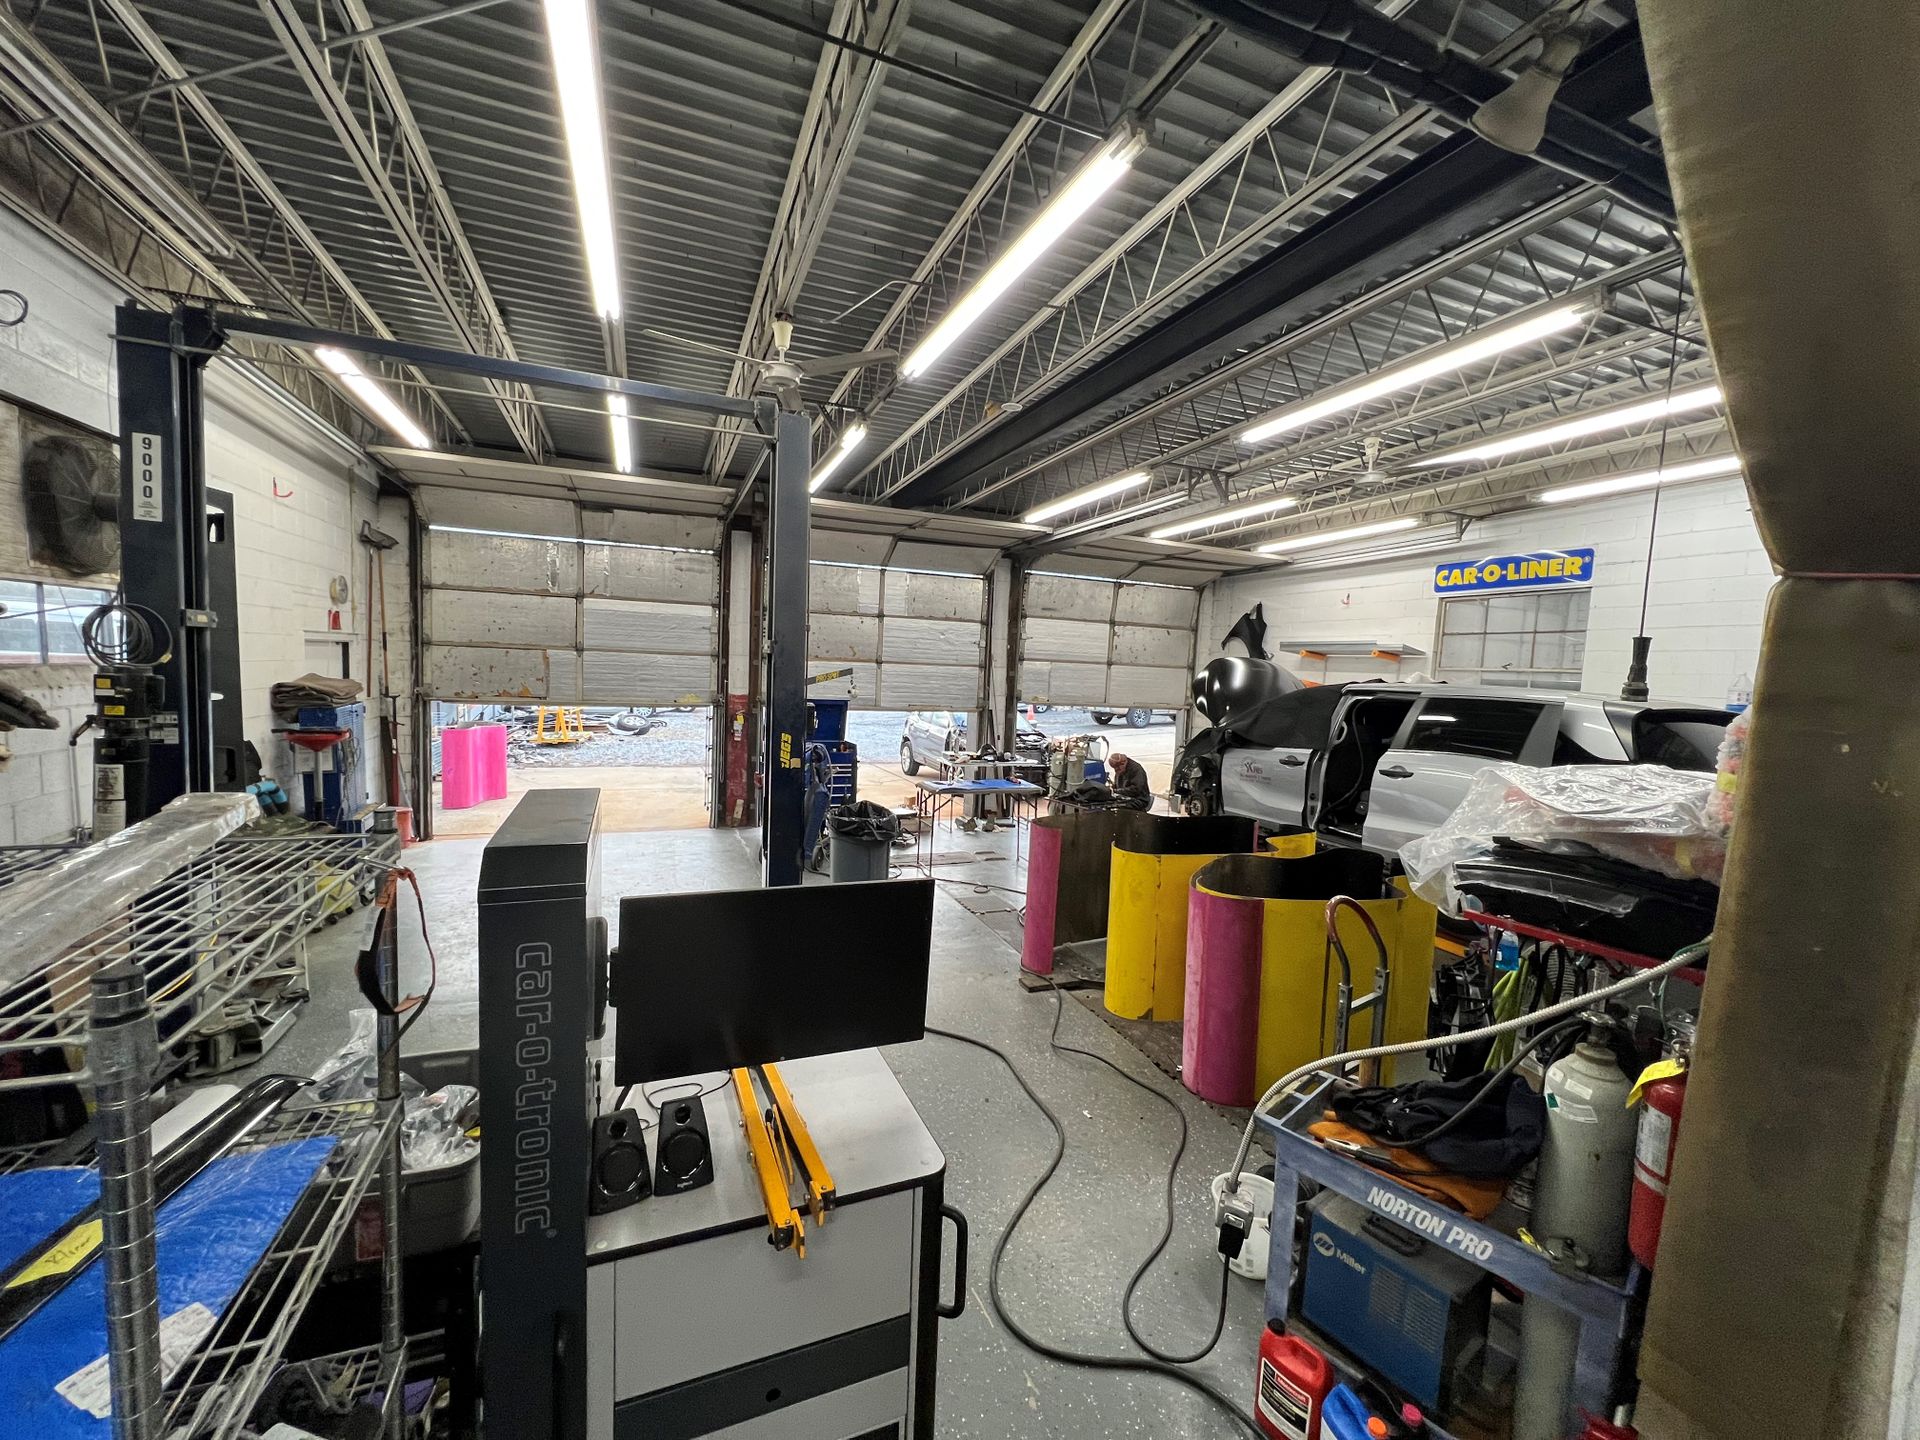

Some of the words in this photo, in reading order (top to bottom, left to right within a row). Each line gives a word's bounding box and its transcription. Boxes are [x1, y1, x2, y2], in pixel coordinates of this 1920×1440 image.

[142, 437, 153, 498] 9000
[1436, 556, 1584, 587] CAR-O-LINER
[780, 732, 792, 769] JEGS
[1367, 1186, 1448, 1238] NORTON
[1445, 1225, 1494, 1261] PRO
[1336, 1248, 1366, 1275] Miller
